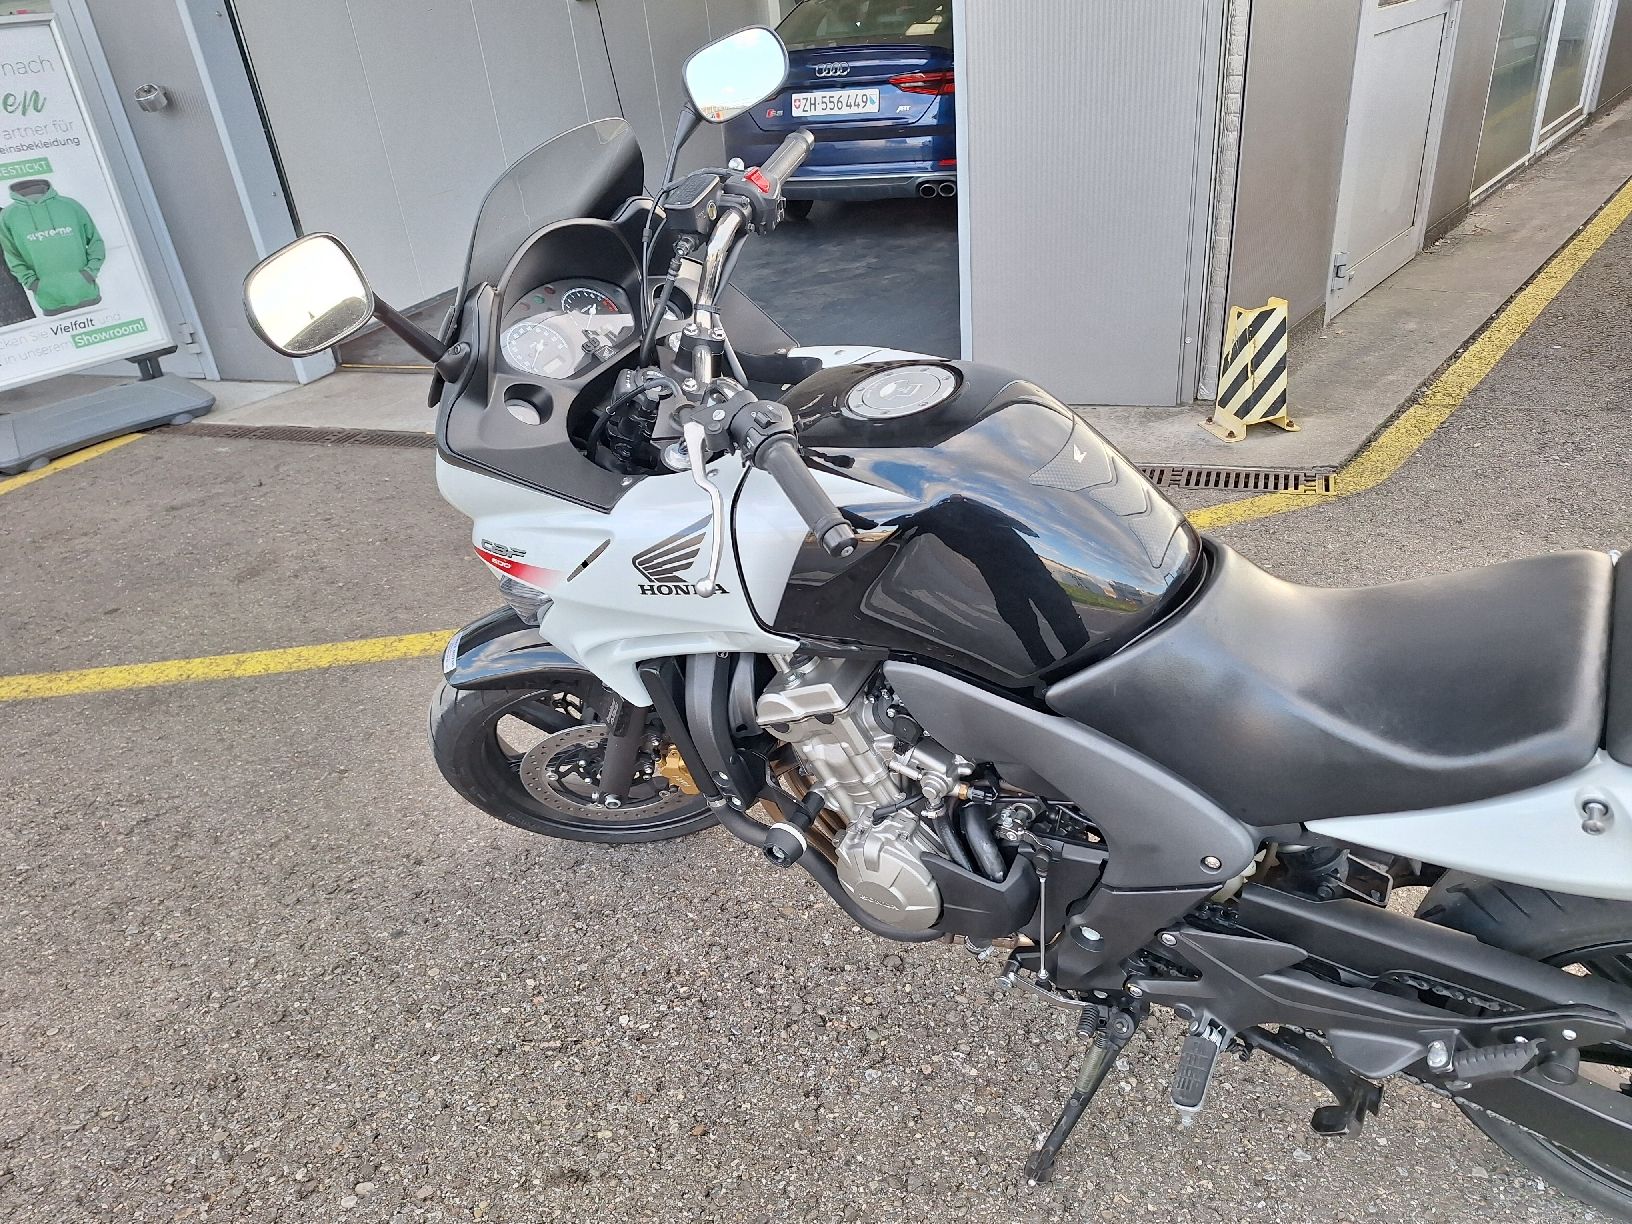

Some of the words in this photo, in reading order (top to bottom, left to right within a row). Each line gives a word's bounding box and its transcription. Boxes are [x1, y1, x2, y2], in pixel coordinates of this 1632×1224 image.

[1, 55, 55, 76] nach
[51, 119, 74, 134] für
[0, 161, 48, 177] ESTICKT
[50, 317, 96, 336] Vielfalt
[75, 321, 145, 346] Showroom!
[638, 584, 730, 596] HONA
